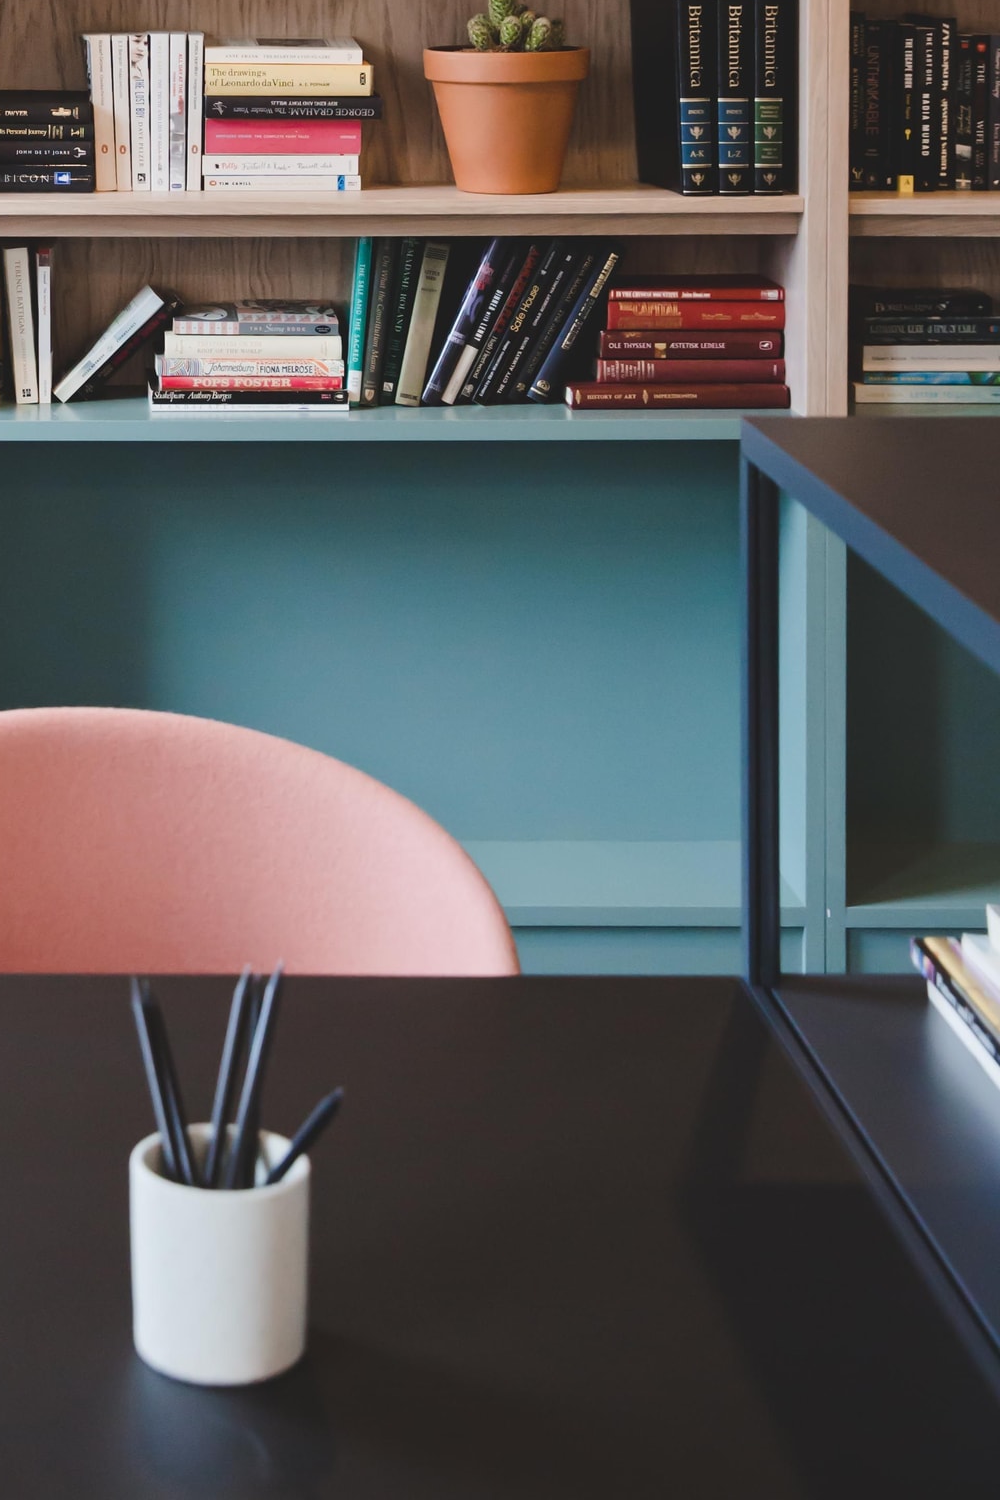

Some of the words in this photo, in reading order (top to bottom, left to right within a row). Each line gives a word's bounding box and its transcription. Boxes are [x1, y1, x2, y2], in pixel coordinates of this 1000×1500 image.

[688, 5, 702, 88] Britannica
[728, 5, 743, 88] Britannica
[764, 5, 778, 88] Britannica
[210, 68, 226, 77] The
[228, 68, 266, 77] drawings
[977, 64, 985, 83] THE
[922, 93, 930, 120] NADIA
[922, 125, 930, 156] MURAD
[976, 121, 984, 144] WIFE
[355, 299, 363, 315] AND
[354, 318, 362, 330] THE
[352, 334, 360, 362] SACRED
[192, 378, 230, 387] POPS
[234, 378, 291, 387] FOSTER
